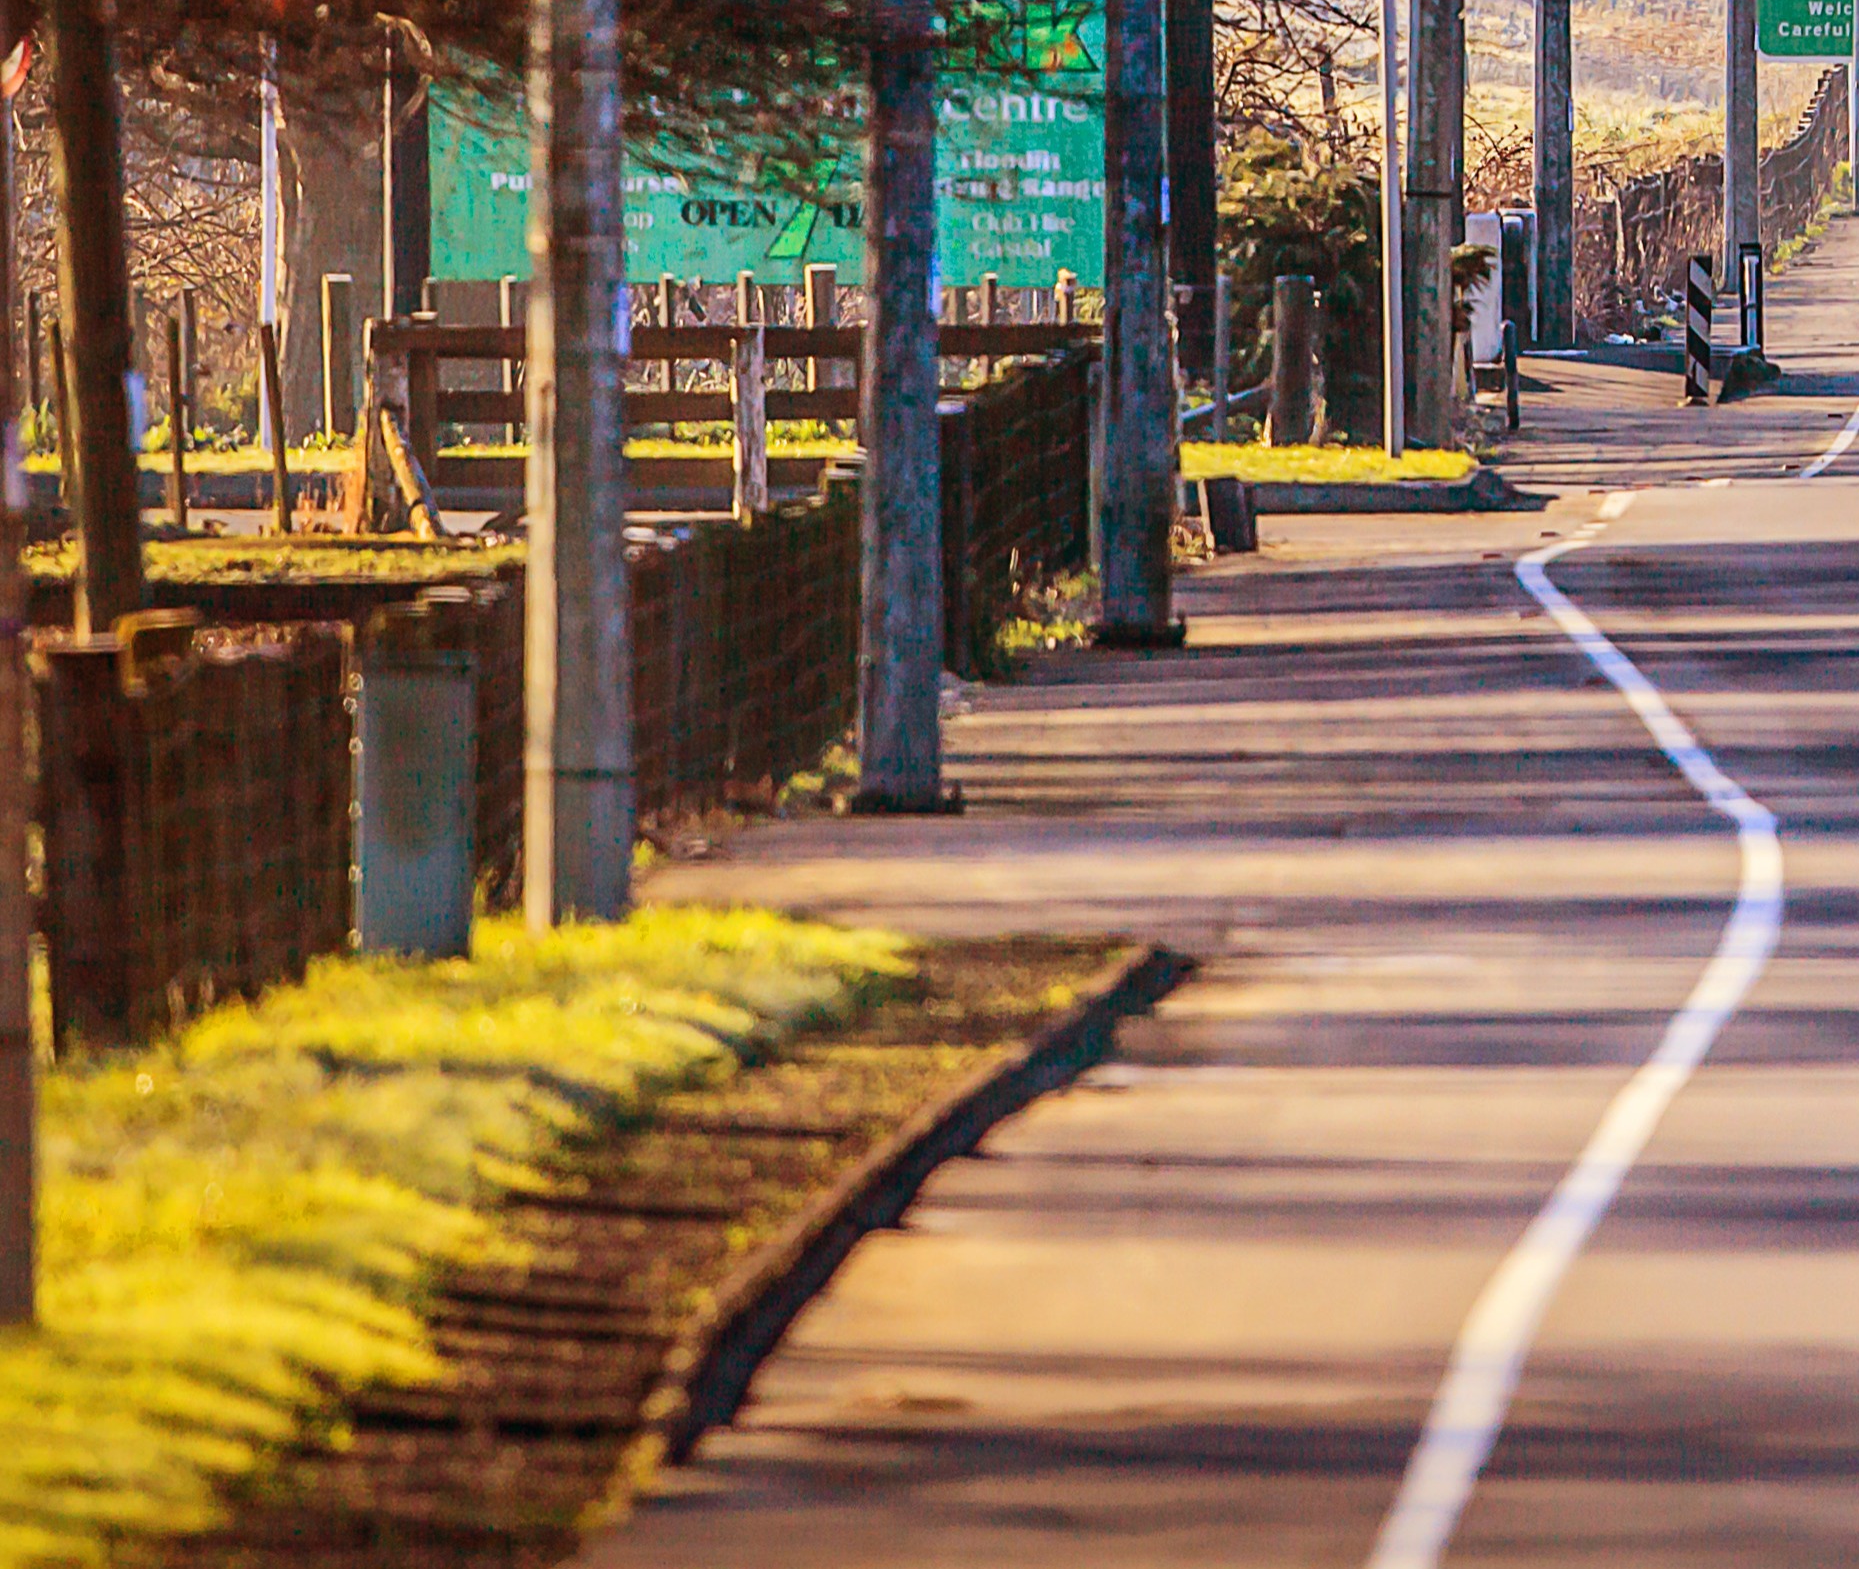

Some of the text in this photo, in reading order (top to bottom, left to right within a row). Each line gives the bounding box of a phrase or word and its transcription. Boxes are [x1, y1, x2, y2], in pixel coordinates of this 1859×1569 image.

[1778, 22, 1850, 37] Careful
[943, 88, 1090, 123] Centre
[681, 199, 778, 229] OPEN
